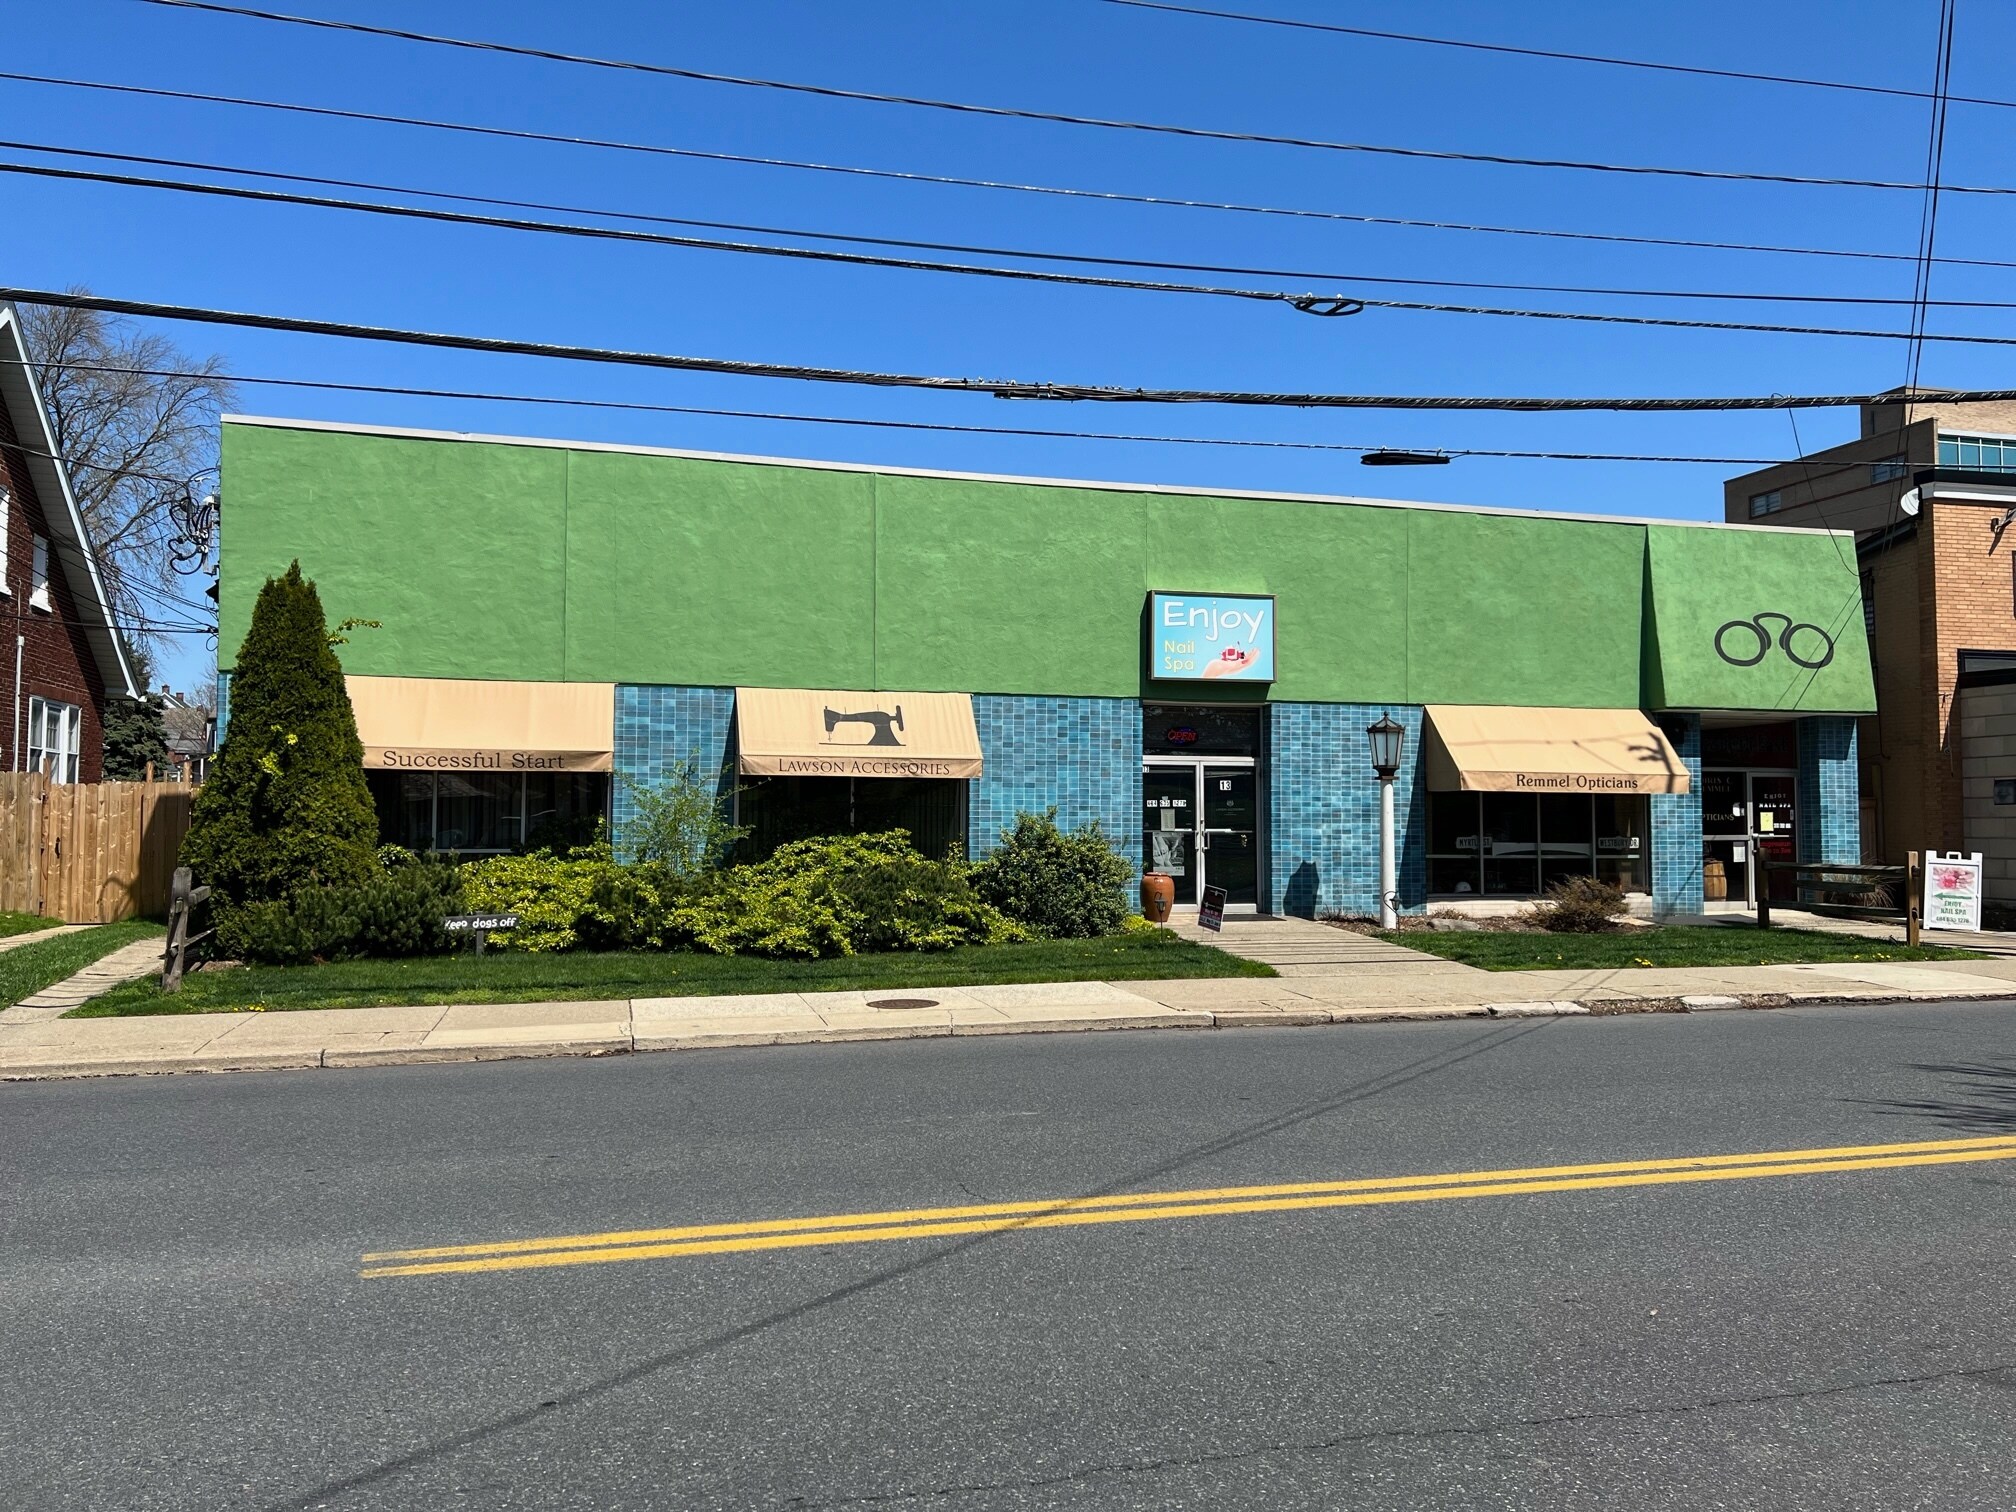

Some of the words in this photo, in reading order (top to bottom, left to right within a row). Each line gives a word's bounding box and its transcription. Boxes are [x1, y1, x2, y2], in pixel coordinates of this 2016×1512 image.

[1164, 600, 1264, 644] Enjoy
[1164, 640, 1195, 654] Nail
[1164, 656, 1194, 672] Spa
[1167, 729, 1197, 742] OPEN
[383, 750, 501, 769] Successful
[512, 752, 565, 769] Start
[779, 758, 844, 773] LAWSON
[851, 760, 950, 775] ACCESSORIES
[1221, 780, 1231, 790] 13
[1516, 774, 1570, 788] Remmel
[1576, 775, 1638, 790] Opticians
[1702, 813, 1735, 822] PTICIANS
[1459, 838, 1480, 847] MYRTL
[472, 918, 498, 929] dogs
[499, 917, 517, 928] off
